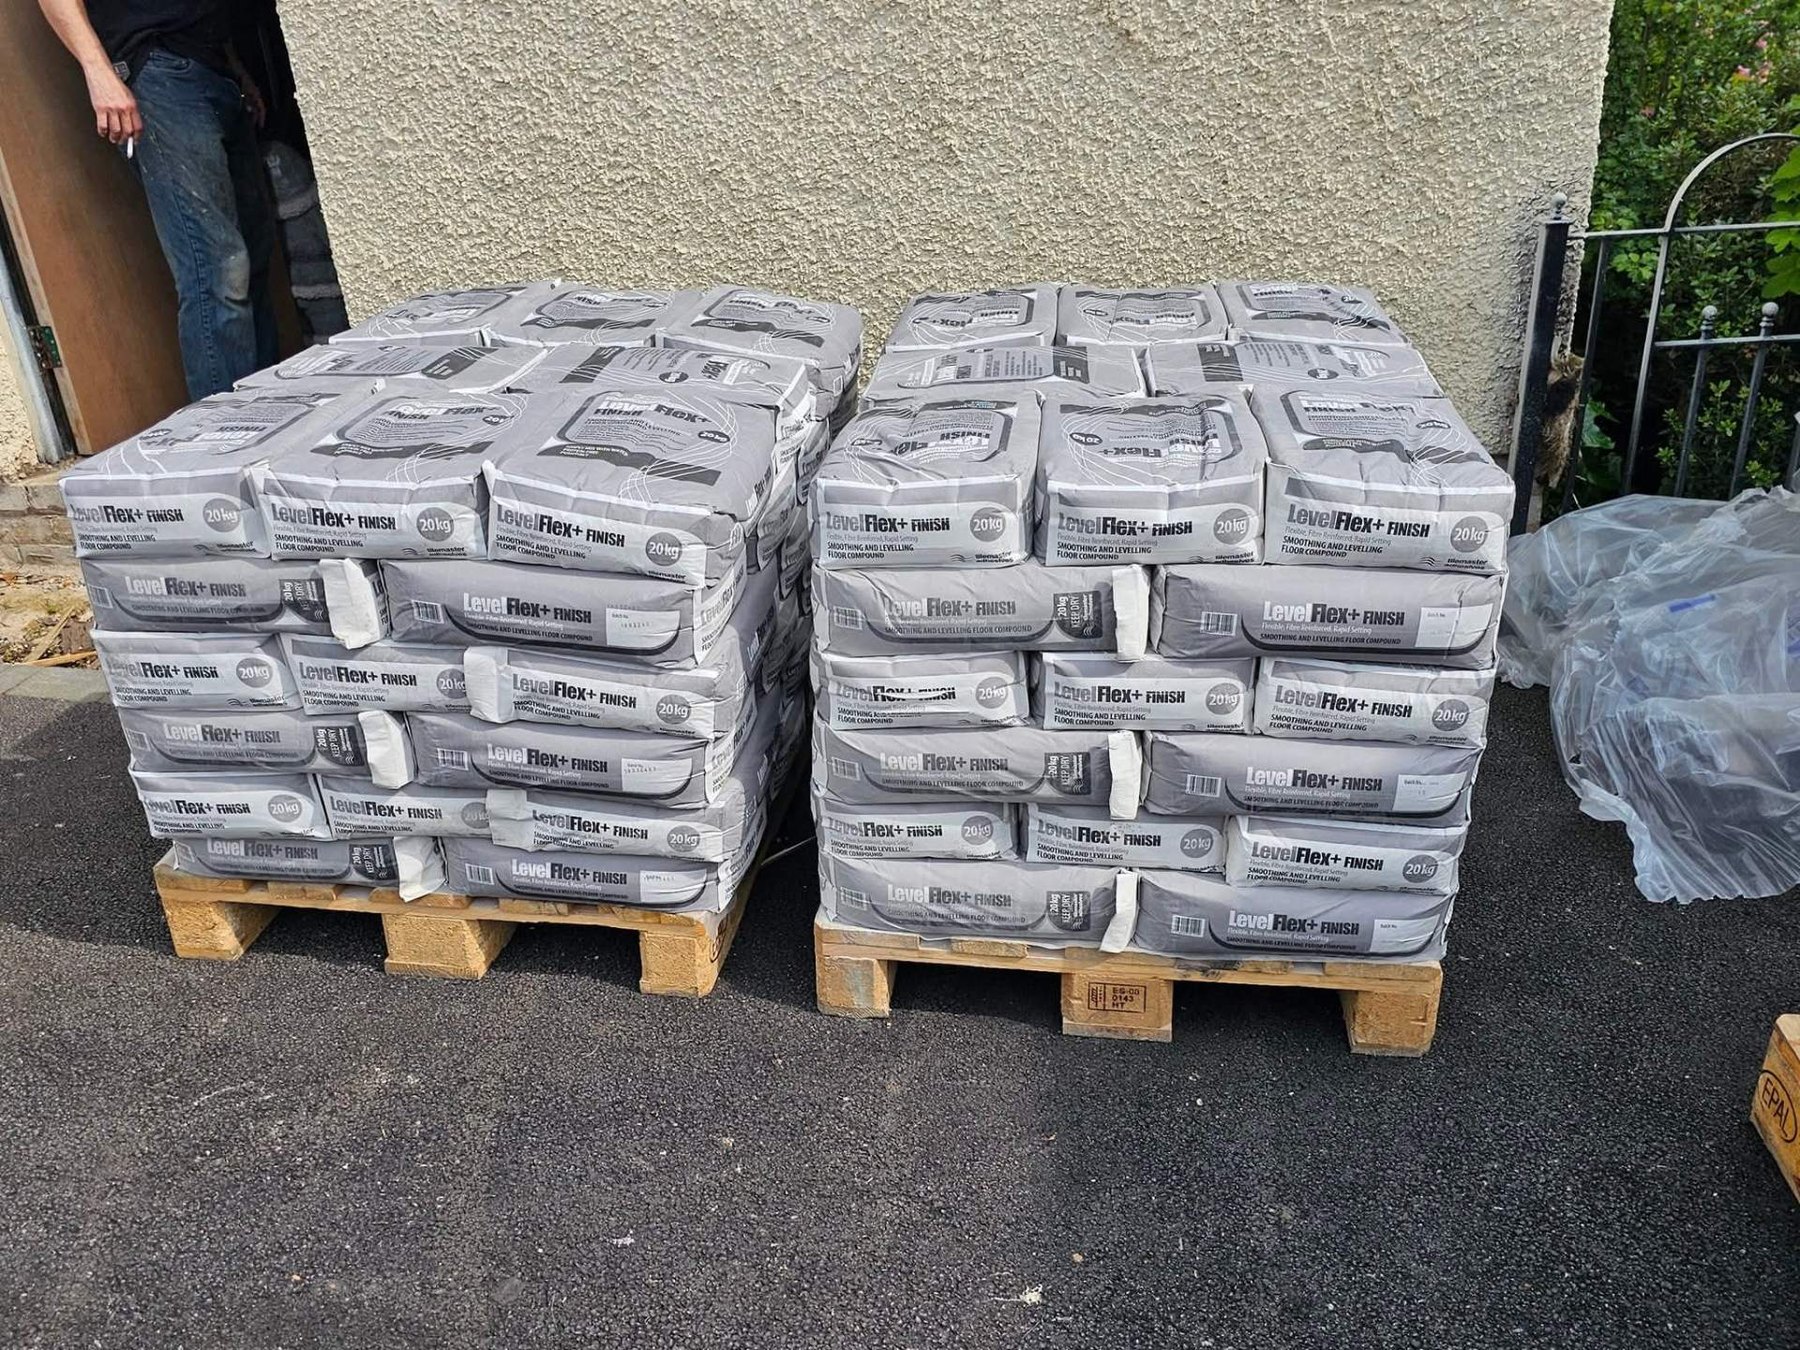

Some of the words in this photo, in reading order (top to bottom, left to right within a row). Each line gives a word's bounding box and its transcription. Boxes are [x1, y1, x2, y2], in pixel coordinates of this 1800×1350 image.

[146, 509, 185, 522] FINISH
[205, 509, 240, 525] 20kg
[271, 503, 354, 528] LevelFlex+
[358, 515, 397, 530] FINISH
[826, 512, 908, 533] LevelFlex+
[911, 517, 951, 533] FINISH
[1287, 503, 1384, 533] LevelFlex+
[1387, 521, 1430, 538] FINISH
[419, 517, 450, 534] 20kg
[497, 504, 583, 538] LevelFlex+
[586, 528, 626, 548] FINISH
[973, 516, 1003, 532] 20kg
[1058, 512, 1149, 537] LevelFlex+
[1152, 521, 1193, 537] FINISH
[1216, 518, 1247, 536] 20kg
[274, 533, 312, 545] SMOOTHING
[328, 540, 363, 548] LEVELLING
[1454, 526, 1487, 545] 20kg
[495, 534, 535, 550] SMOOTHING
[535, 543, 550, 553] AND
[550, 547, 586, 559] LEVELLING
[650, 541, 679, 561] 20kg
[828, 541, 864, 551] SMOOTHING
[864, 542, 879, 551] AND
[879, 543, 914, 551] LEVELLING
[1057, 541, 1099, 553] SMOOTHING
[1099, 545, 1114, 554] AND
[1114, 546, 1152, 555] LEVELLING
[1281, 544, 1305, 555] FLOOR
[1305, 548, 1347, 558] COMPOUND
[1283, 535, 1326, 550] SMOOTHING
[1327, 541, 1344, 551] AND
[1344, 543, 1383, 555] LEVELLING
[828, 551, 848, 559] FLOOR
[848, 551, 885, 559] COMPOUND
[1057, 550, 1078, 559] FLOOR
[1079, 552, 1119, 560] COMPOUND
[209, 582, 247, 598] FINISH
[463, 592, 550, 619] LevelFlex+
[553, 606, 592, 624] FINISH
[976, 601, 1016, 616] FINISH
[1057, 596, 1068, 618] 20kg
[1262, 600, 1360, 625] LevelFlex+
[1362, 610, 1405, 626] FINISH
[182, 666, 219, 679] FINISH
[240, 665, 270, 681] 20kg
[299, 662, 378, 684] LevelFlex+
[380, 673, 418, 687] FINISH
[302, 689, 339, 700] SMOOTHING
[352, 694, 386, 702] LEVELLING
[512, 673, 597, 701] LevelFlex+
[600, 692, 637, 709] FINISH
[1054, 682, 1143, 703] LevelFlex+
[1146, 691, 1186, 704] FINISH
[1274, 685, 1369, 713] LevelFlex+
[1371, 702, 1413, 718] FINISH
[659, 702, 689, 719] 20kg
[1054, 707, 1094, 719] SMOOTHING
[1094, 712, 1108, 720] AND
[1108, 713, 1146, 721] LEVELLING
[1435, 709, 1466, 724] 20kg
[1054, 714, 1075, 725] FLOOR
[1075, 717, 1114, 726] COMPOUND
[1269, 721, 1292, 731] FLOOR
[1292, 724, 1334, 733] COMPOUND
[1271, 713, 1313, 726] SMOOTHING
[1313, 719, 1330, 728] AND
[1330, 720, 1368, 731] LEVELLING
[244, 730, 281, 743] FINISH
[487, 743, 569, 767] LevelFlex+
[571, 757, 608, 773] FINISH
[969, 757, 1008, 771] FINISH
[1245, 766, 1340, 790] LevelFlex+
[1341, 777, 1383, 792] FINISH
[216, 803, 251, 815] FINISH
[270, 802, 300, 815] 20kg
[329, 796, 405, 817] LevelFlex+
[407, 807, 443, 819] FINISH
[613, 825, 649, 840] FINISH
[670, 832, 699, 846] 20kg
[906, 825, 943, 837] FINISH
[963, 825, 991, 837] 20kg
[1123, 833, 1162, 847] FINISH
[1182, 838, 1211, 850] 20kg
[285, 846, 319, 860] FINISH
[1037, 843, 1074, 856] SMOOTHING
[1089, 852, 1124, 861] LEVELLING
[1251, 841, 1342, 866] LevelFlex+
[1343, 856, 1385, 871] FINISH
[511, 859, 590, 881] LevelFlex+
[593, 871, 627, 885] FINISH
[1248, 866, 1289, 878] SMOOTHING
[1289, 871, 1305, 879] AND
[1305, 873, 1341, 883] LEVELLING
[1405, 862, 1439, 877] 20kg
[1228, 909, 1318, 933] LevelFlex+
[1320, 920, 1360, 936] FINISH
[1112, 995, 1134, 1003] 0143
[1761, 1077, 1789, 1138] EPAL
